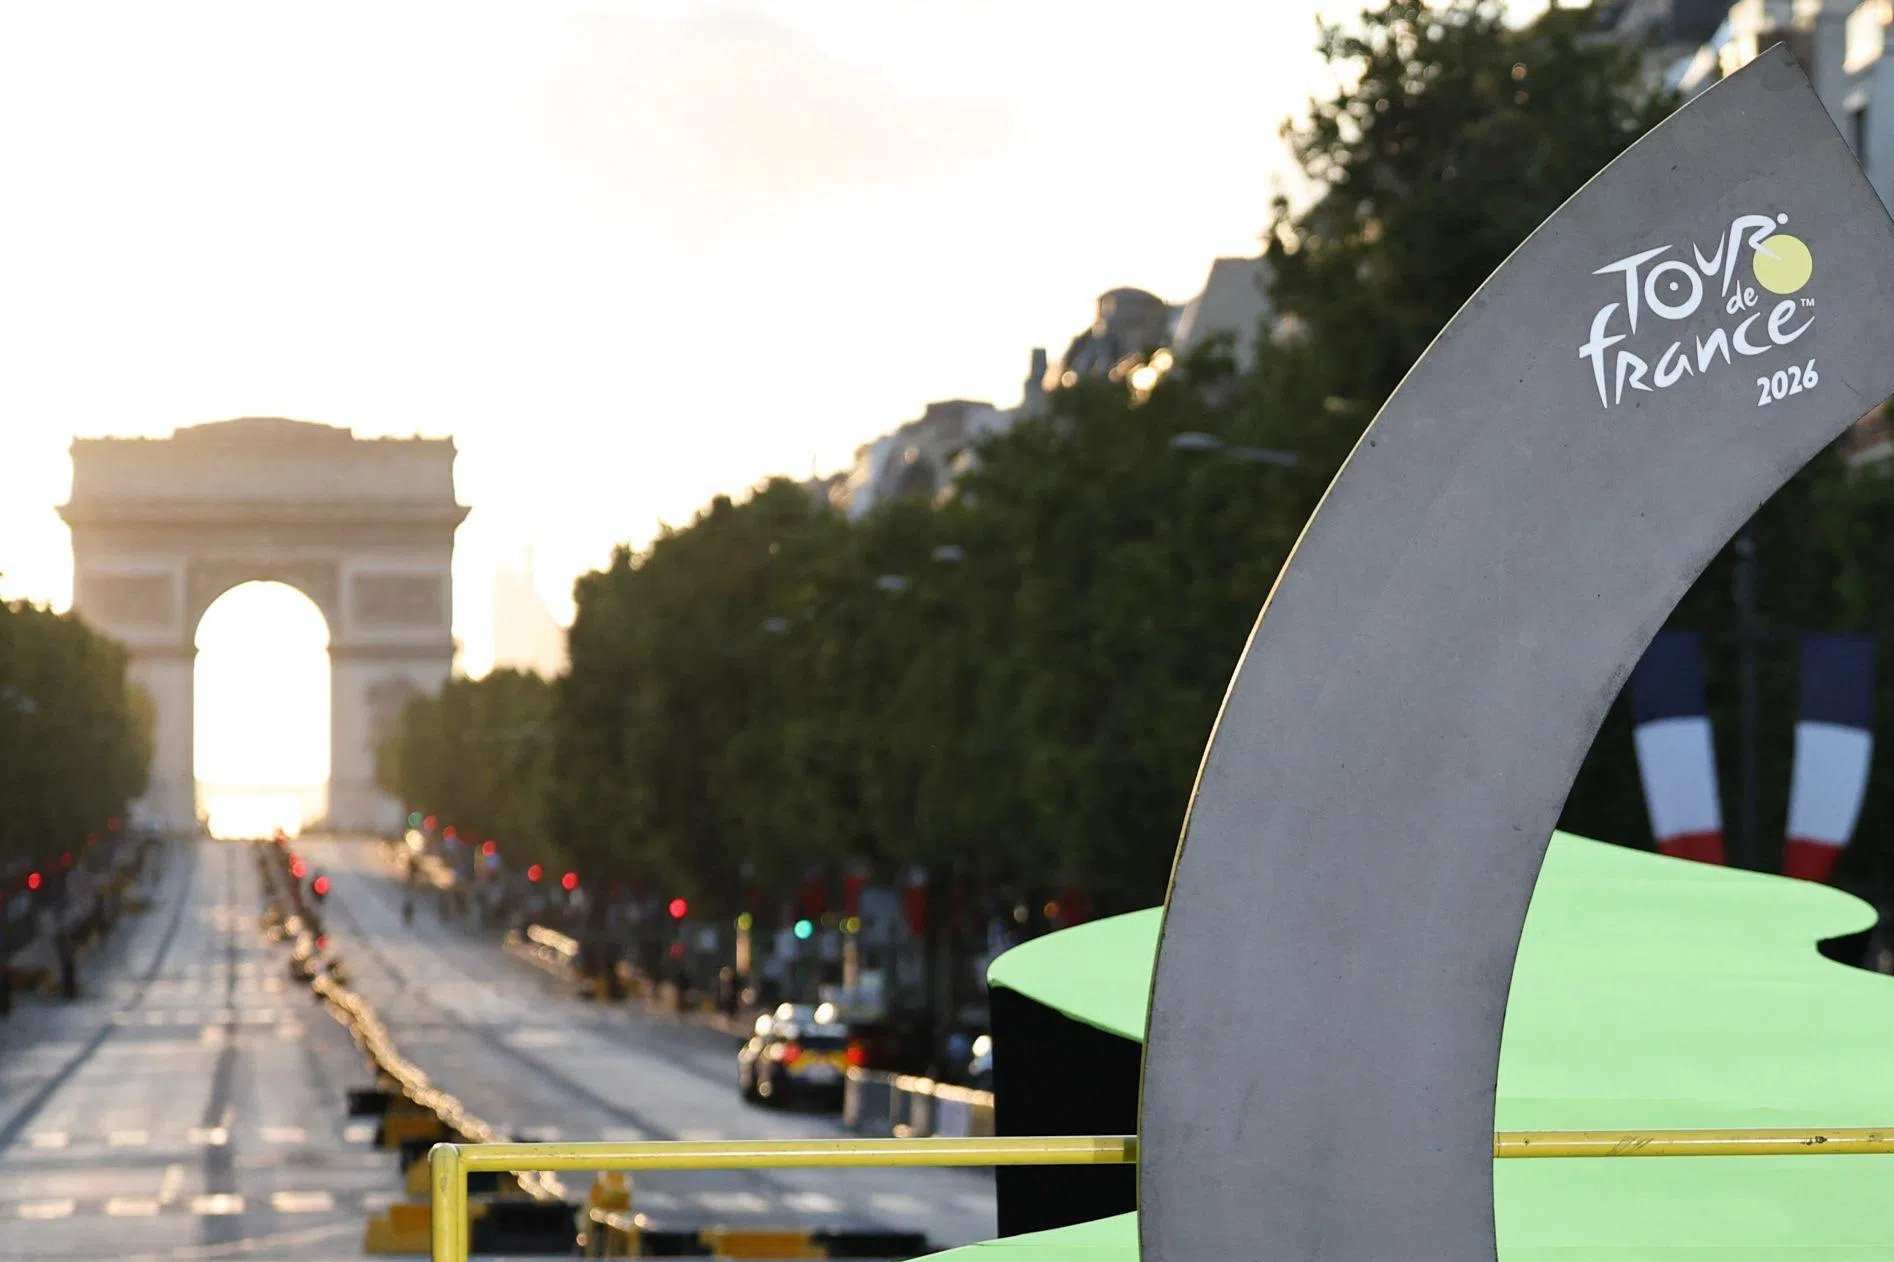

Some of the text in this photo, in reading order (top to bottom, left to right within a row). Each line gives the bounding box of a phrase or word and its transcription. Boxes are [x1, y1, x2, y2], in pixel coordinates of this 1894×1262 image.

[1592, 213, 1789, 334] TOUR
[1725, 280, 1758, 315] de
[1756, 359, 1819, 407] 2026
